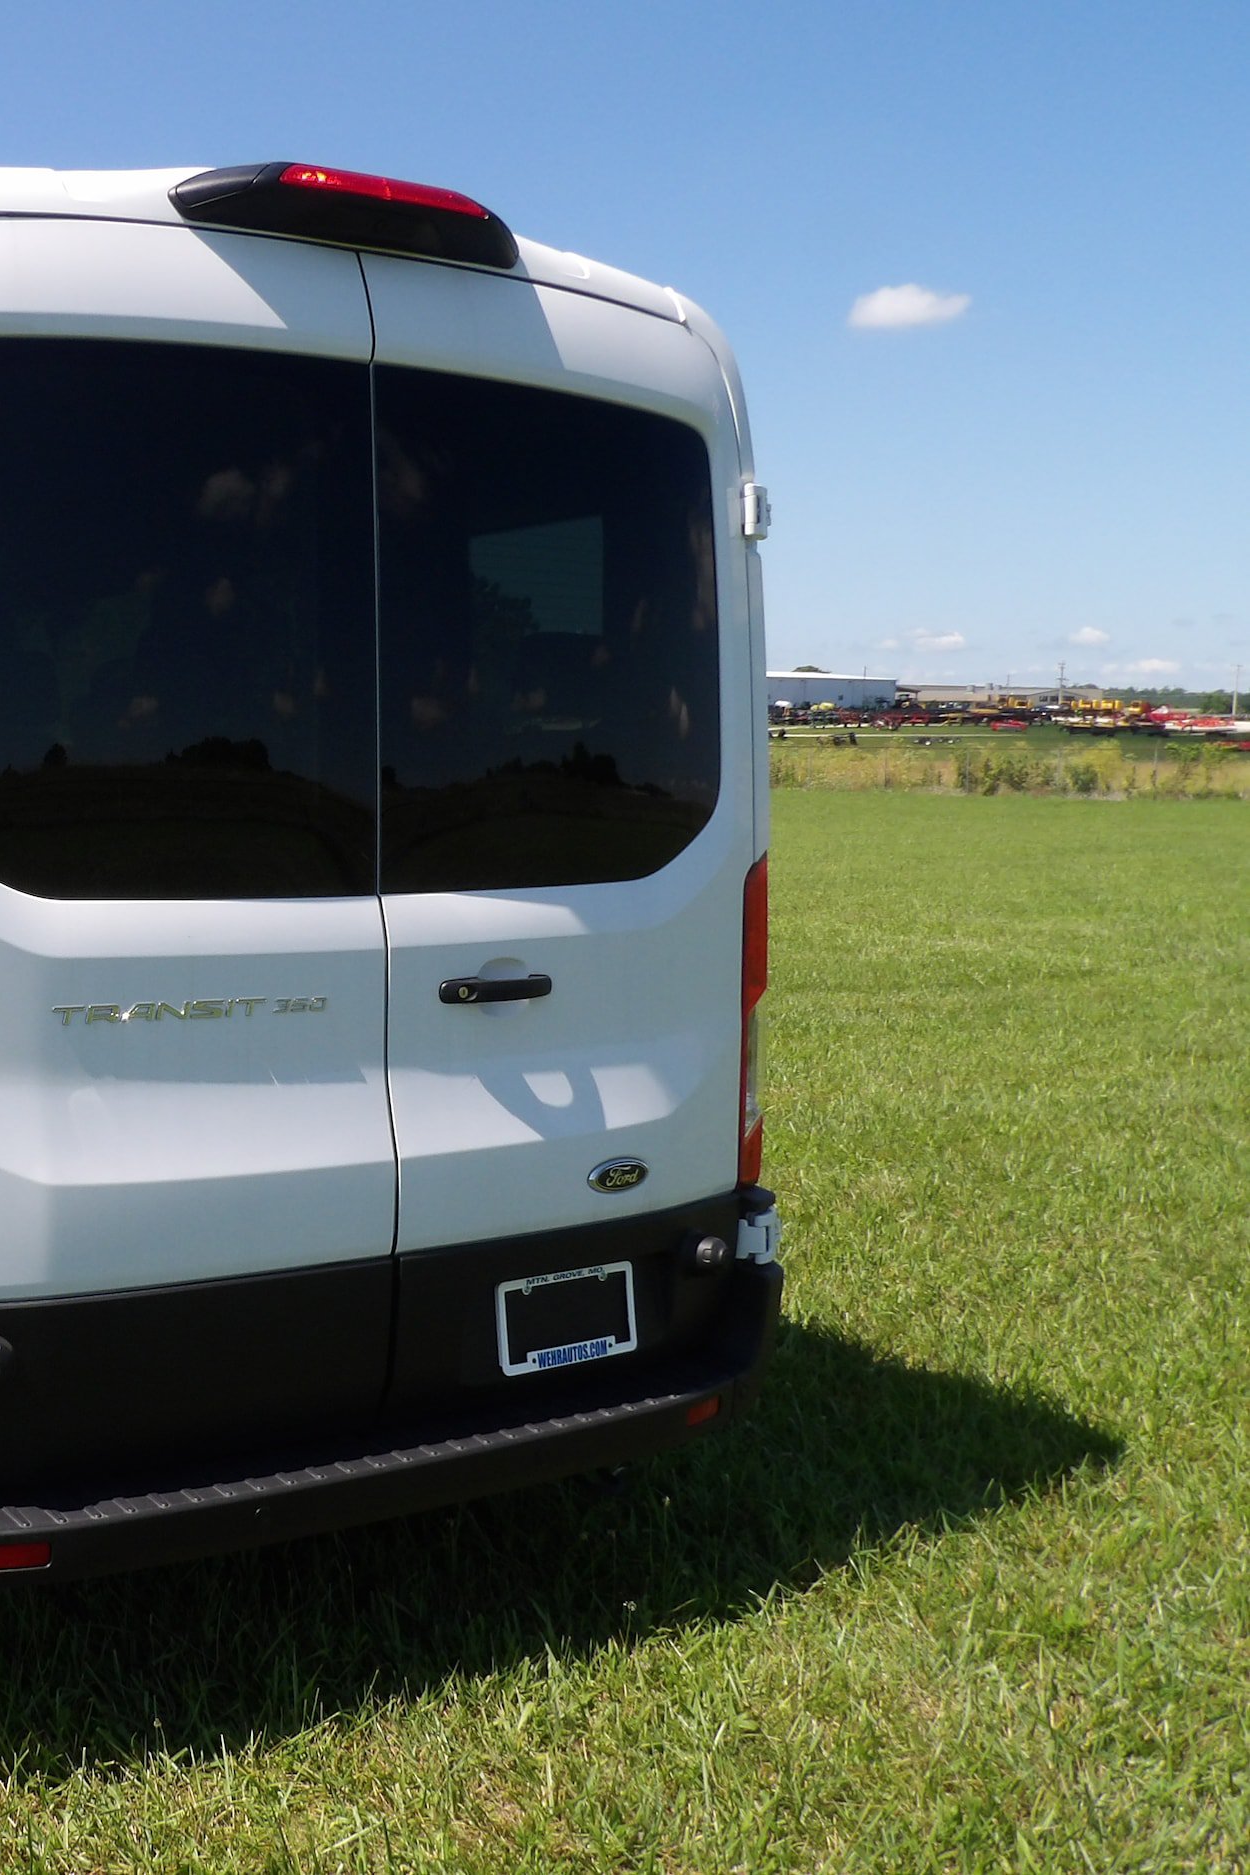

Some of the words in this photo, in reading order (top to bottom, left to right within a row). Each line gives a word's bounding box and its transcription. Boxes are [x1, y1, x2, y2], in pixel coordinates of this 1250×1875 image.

[52, 998, 267, 1025] TRANSIT
[605, 1166, 639, 1187] Ford
[537, 1339, 608, 1368] WEHRAUTOS.COM
